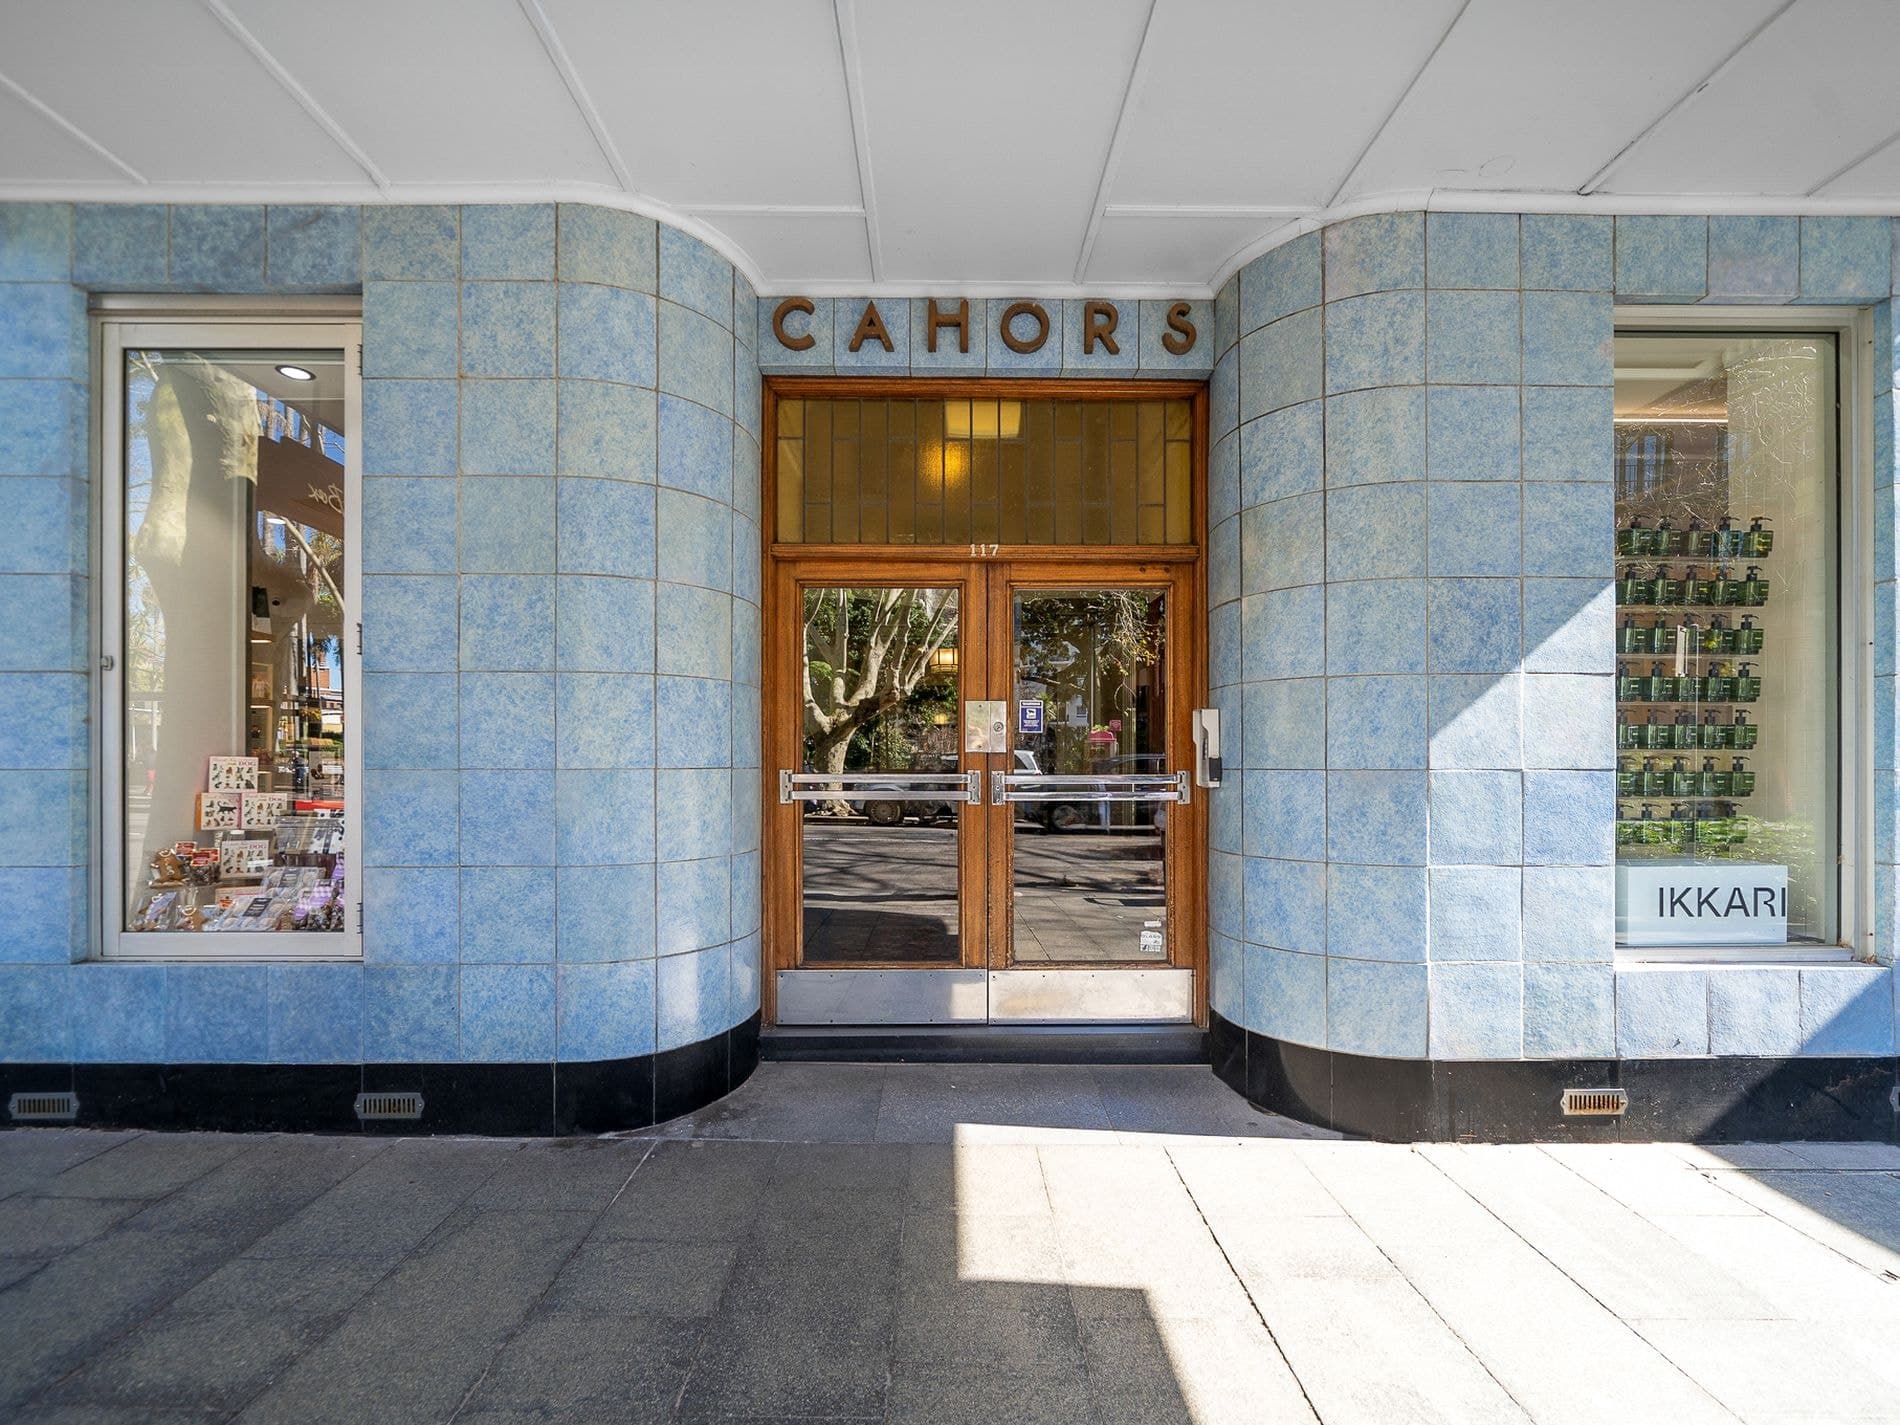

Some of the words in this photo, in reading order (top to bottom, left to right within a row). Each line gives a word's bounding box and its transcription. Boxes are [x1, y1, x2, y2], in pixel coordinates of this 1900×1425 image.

[772, 297, 1197, 355] CAHORS
[970, 543, 999, 558] 117
[1658, 887, 1787, 918] IKKARI
